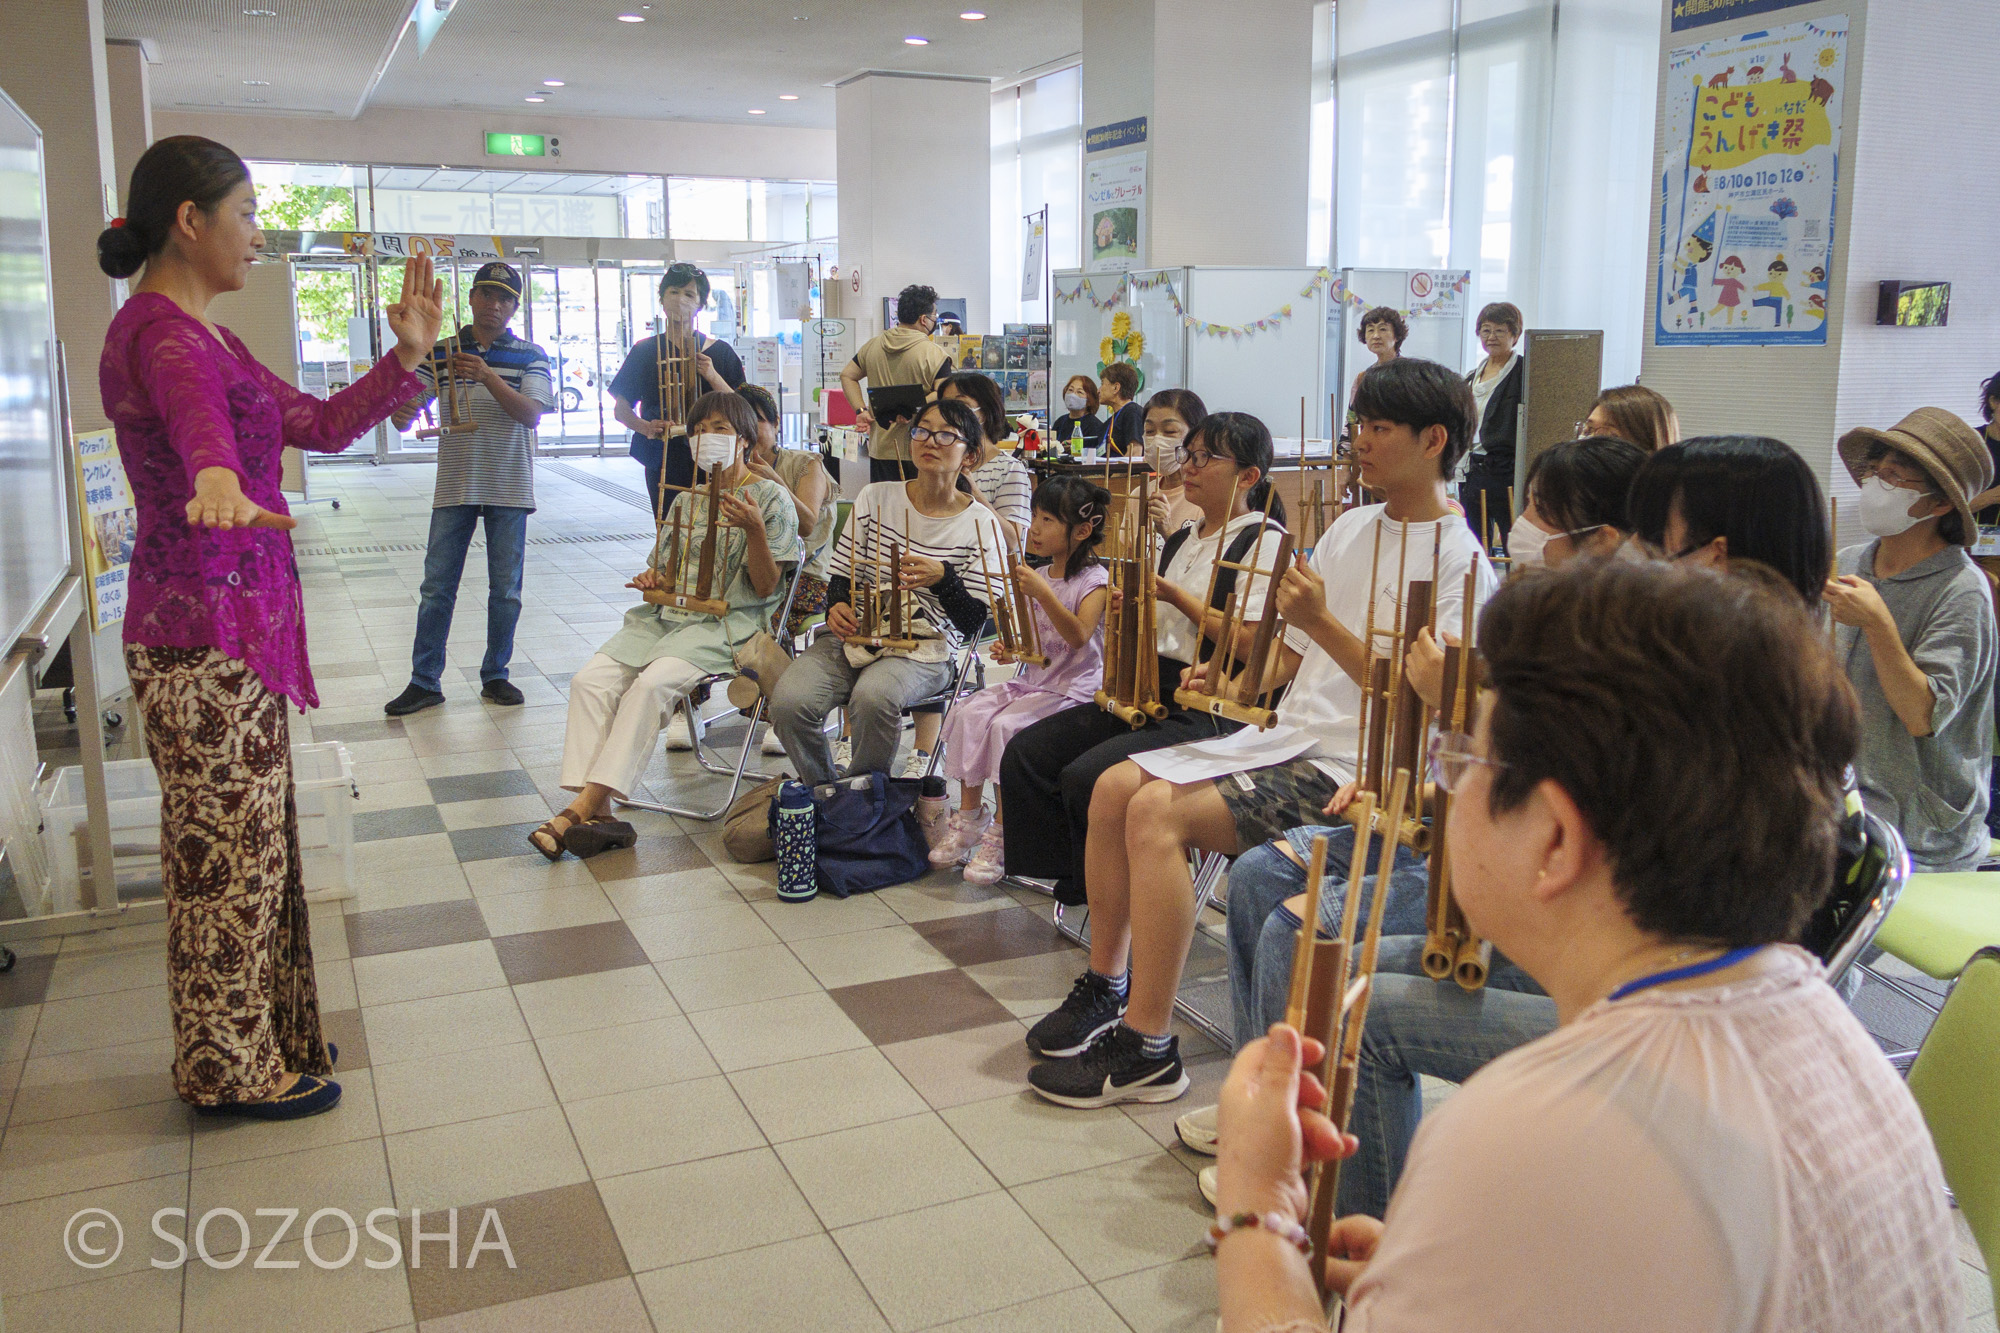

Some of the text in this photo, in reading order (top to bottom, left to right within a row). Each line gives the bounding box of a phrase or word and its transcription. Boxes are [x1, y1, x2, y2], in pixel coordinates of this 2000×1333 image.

[1703, 92, 1759, 121] こども
[1697, 118, 1805, 155] えんげき祭
[1089, 184, 1142, 202] ヘンゼルとグレーテル
[1212, 703, 1220, 713] 4
